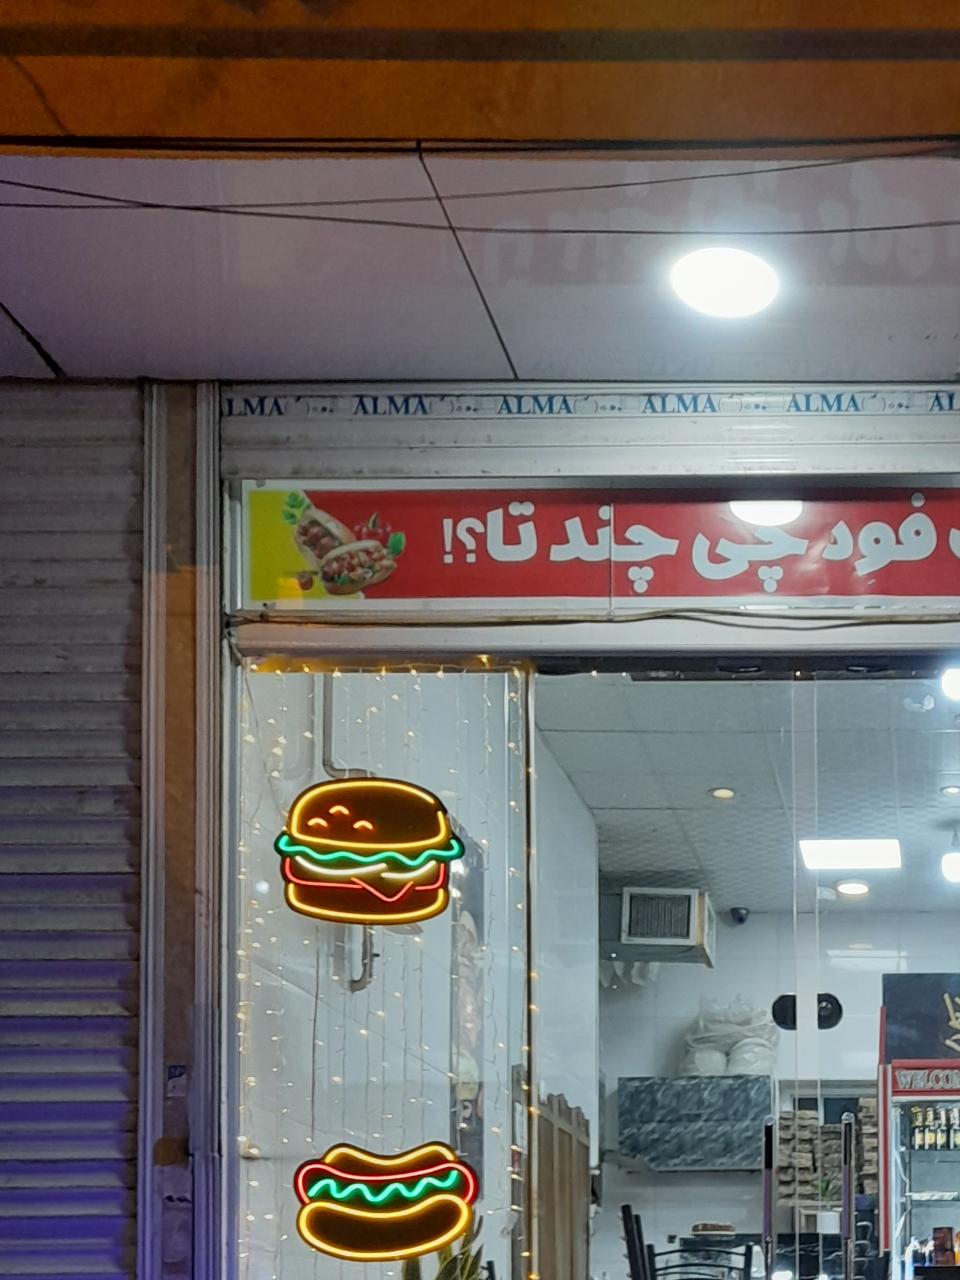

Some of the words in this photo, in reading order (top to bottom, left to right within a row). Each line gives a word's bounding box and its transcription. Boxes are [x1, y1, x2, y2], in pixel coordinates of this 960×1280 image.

[226, 397, 284, 416] LMA
[353, 394, 429, 415] ALMA
[497, 394, 573, 414] ALMA
[642, 392, 718, 414] ALMA
[786, 392, 862, 413] ALMA
[824, 492, 938, 576] فود
[549, 504, 681, 594] چند
[691, 524, 810, 593] چی
